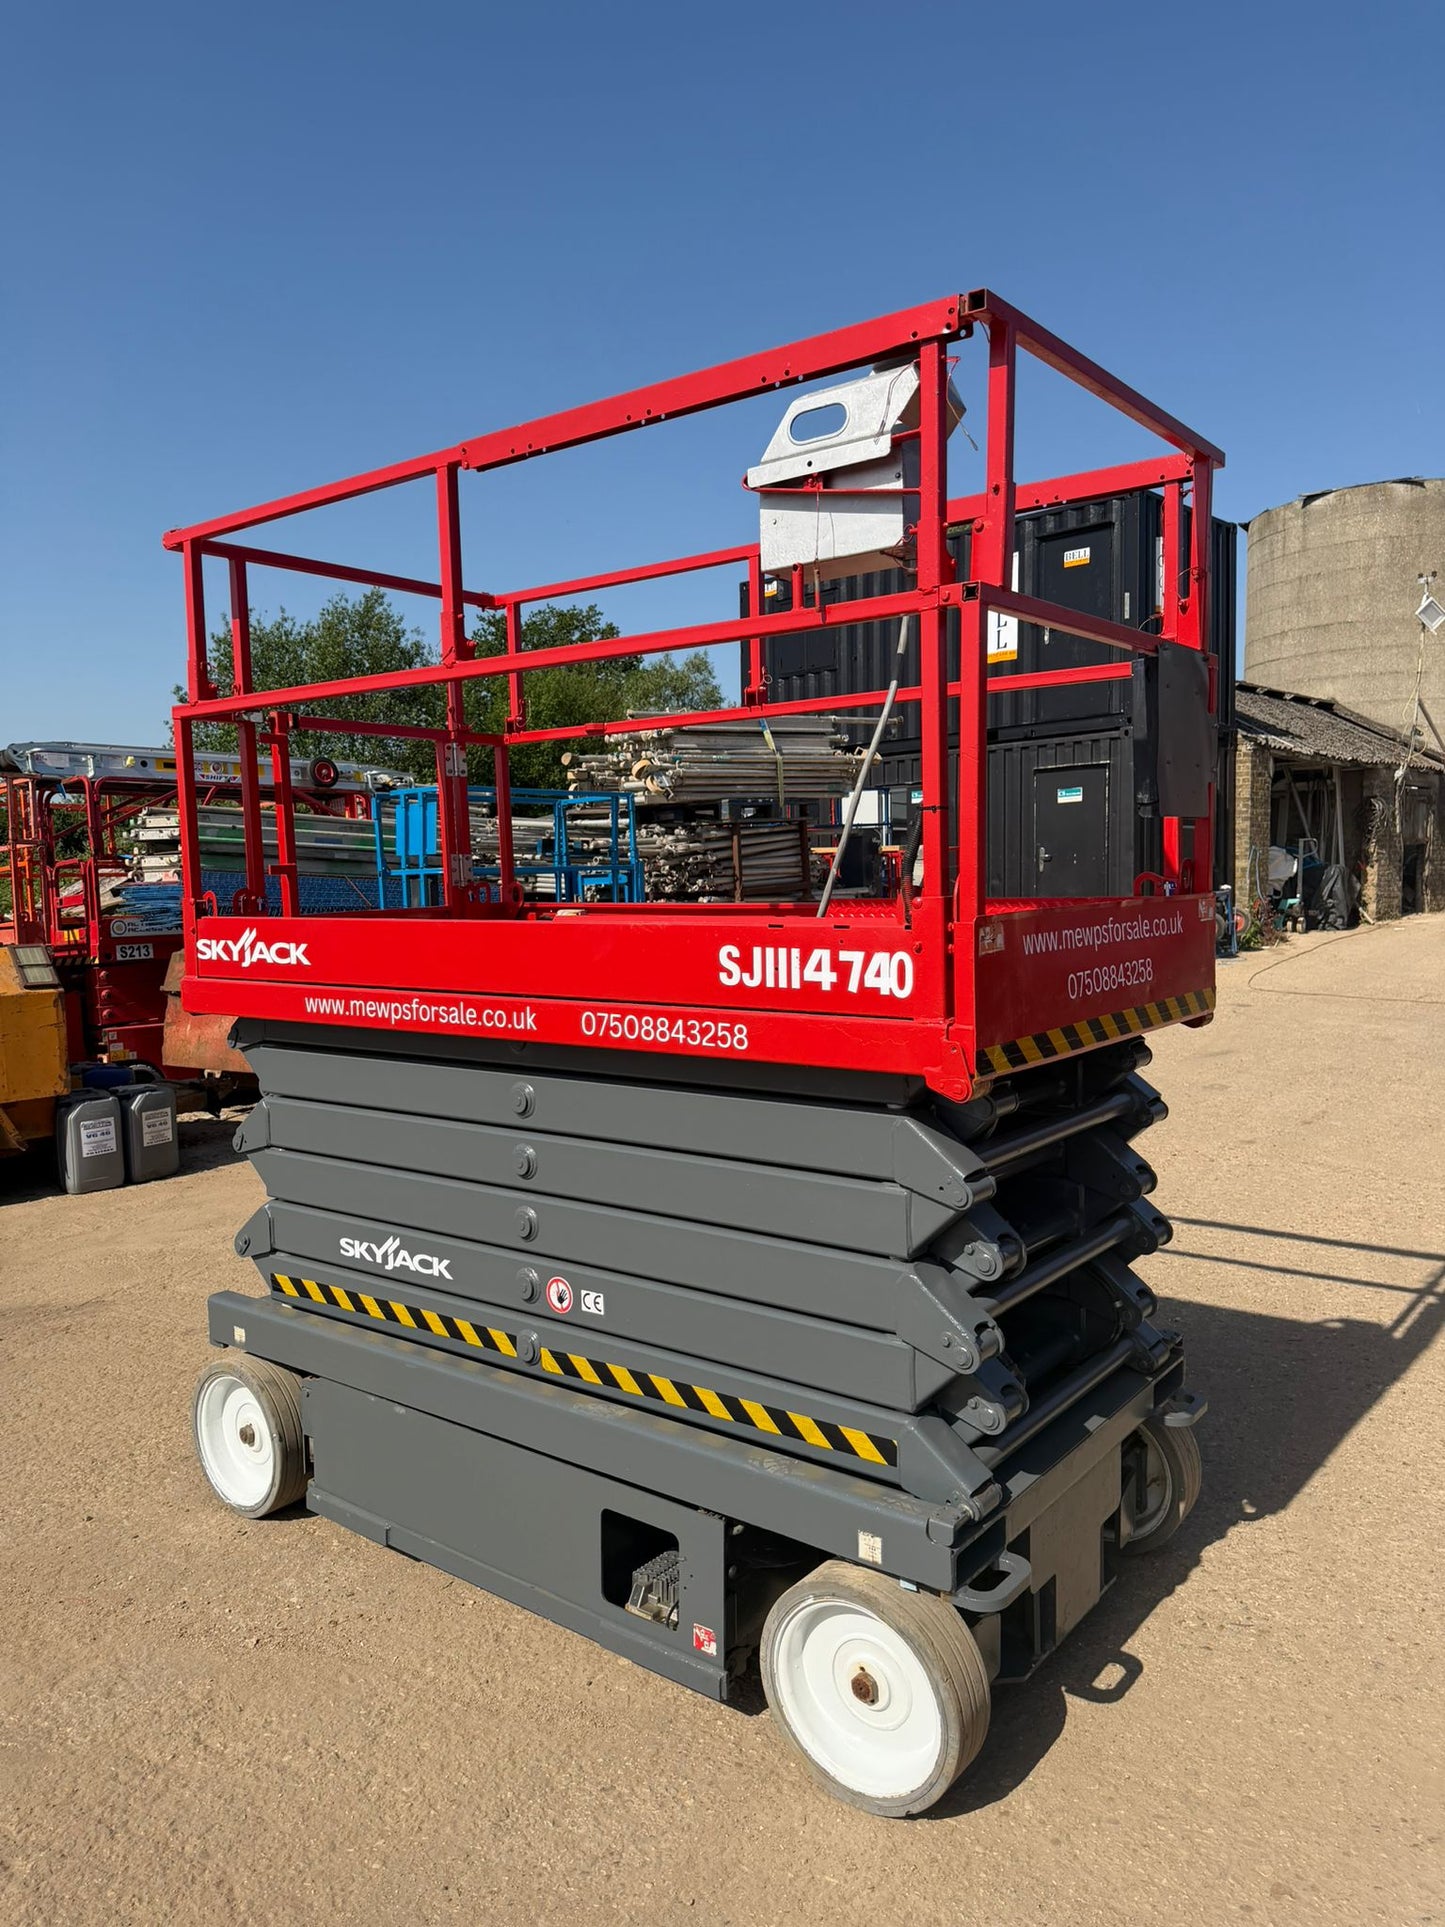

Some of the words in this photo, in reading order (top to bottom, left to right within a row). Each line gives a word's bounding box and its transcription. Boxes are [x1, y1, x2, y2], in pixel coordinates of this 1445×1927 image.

[1065, 549, 1090, 561] BELL
[120, 945, 150, 958] S213
[196, 927, 311, 967] SKYJACK
[1023, 910, 1183, 955] www.mewpsforsale.co.uk
[1068, 958, 1154, 999] 07508843258
[305, 996, 537, 1031] www.mewpsforsale.co.uk
[581, 1011, 749, 1050] 07508843258
[339, 1235, 454, 1280] SKYJACK
[583, 1292, 602, 1312] CE
